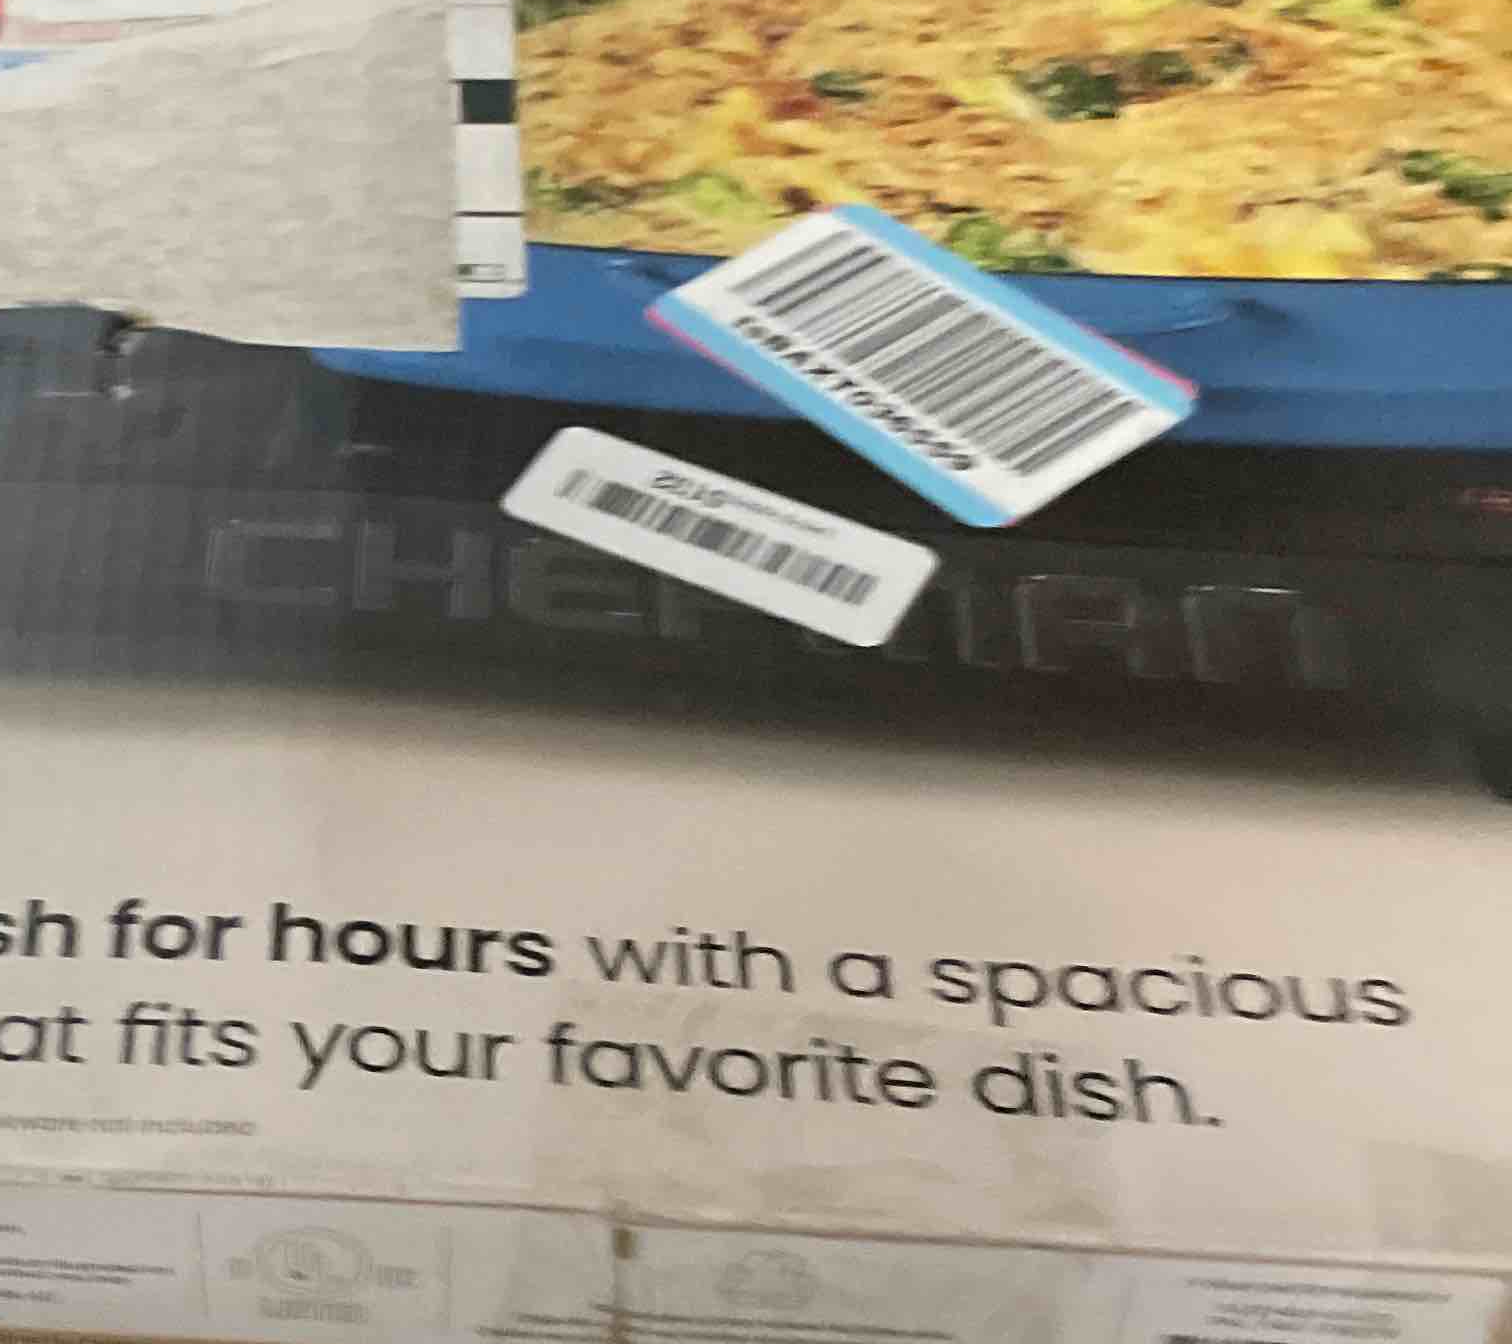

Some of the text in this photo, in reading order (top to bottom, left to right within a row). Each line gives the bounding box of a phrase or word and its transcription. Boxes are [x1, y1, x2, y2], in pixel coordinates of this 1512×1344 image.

[106, 897, 245, 961] for
[268, 901, 555, 977] hours
[585, 926, 794, 994] with
[827, 948, 895, 1000] a
[931, 953, 1413, 1028] spacious
[118, 1000, 258, 1068] fits
[291, 1020, 517, 1090] your
[545, 1022, 936, 1111] favorite
[971, 1050, 1226, 1130] dish.
